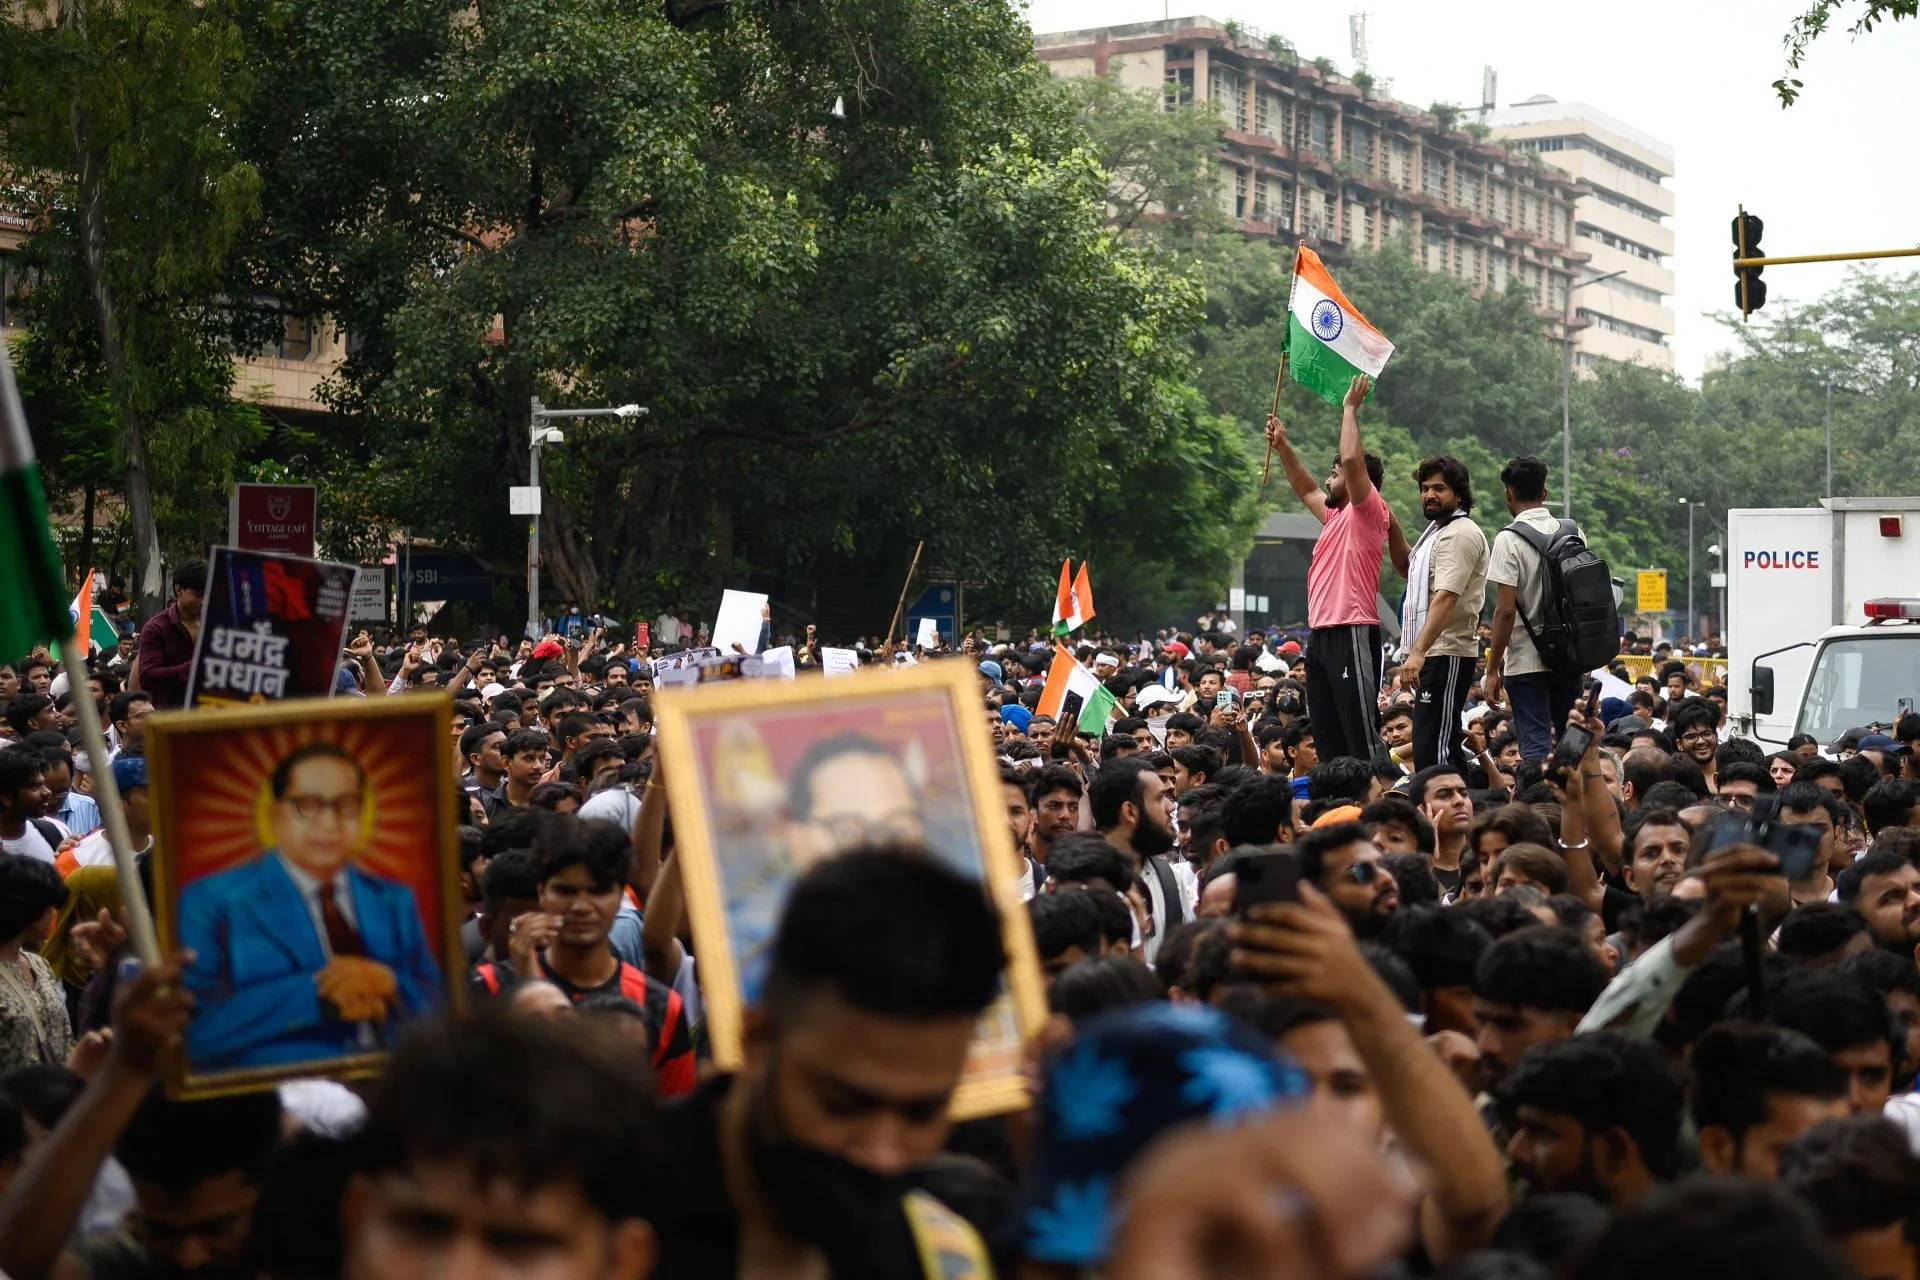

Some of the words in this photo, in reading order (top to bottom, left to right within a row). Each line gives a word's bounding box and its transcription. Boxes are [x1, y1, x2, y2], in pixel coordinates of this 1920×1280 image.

[249, 523, 286, 533] COTTAGE
[1744, 551, 1819, 569] POLICE
[360, 573, 381, 583] rium
[415, 569, 438, 584] SBI
[202, 656, 290, 698] प्रधान
